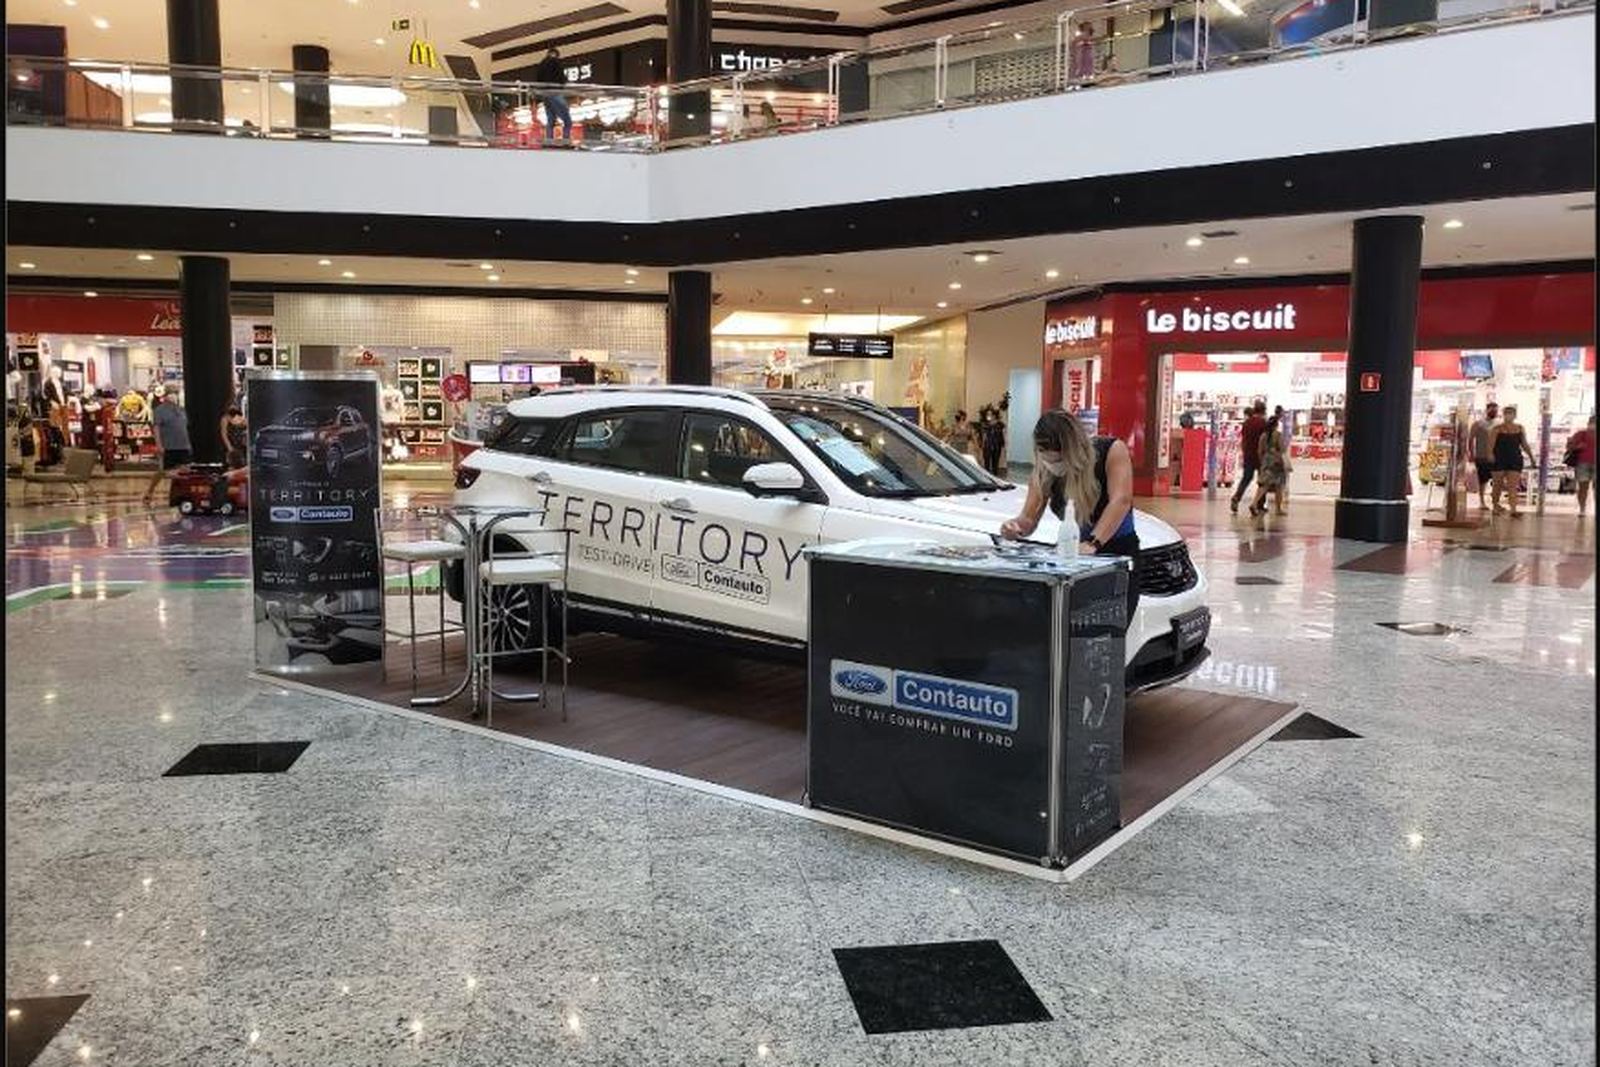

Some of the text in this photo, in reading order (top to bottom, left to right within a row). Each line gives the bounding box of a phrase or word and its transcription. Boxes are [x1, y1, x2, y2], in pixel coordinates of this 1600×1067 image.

[1057, 315, 1096, 343] biscuit
[1147, 303, 1296, 333] Le biscuit
[259, 489, 369, 501] TERRITORY
[537, 490, 807, 581] TERRITORY
[704, 569, 764, 595] Contauto
[902, 680, 1008, 717] Contauto
[832, 702, 1014, 748] VOCÊ VAI COMPRAR UM FORD
